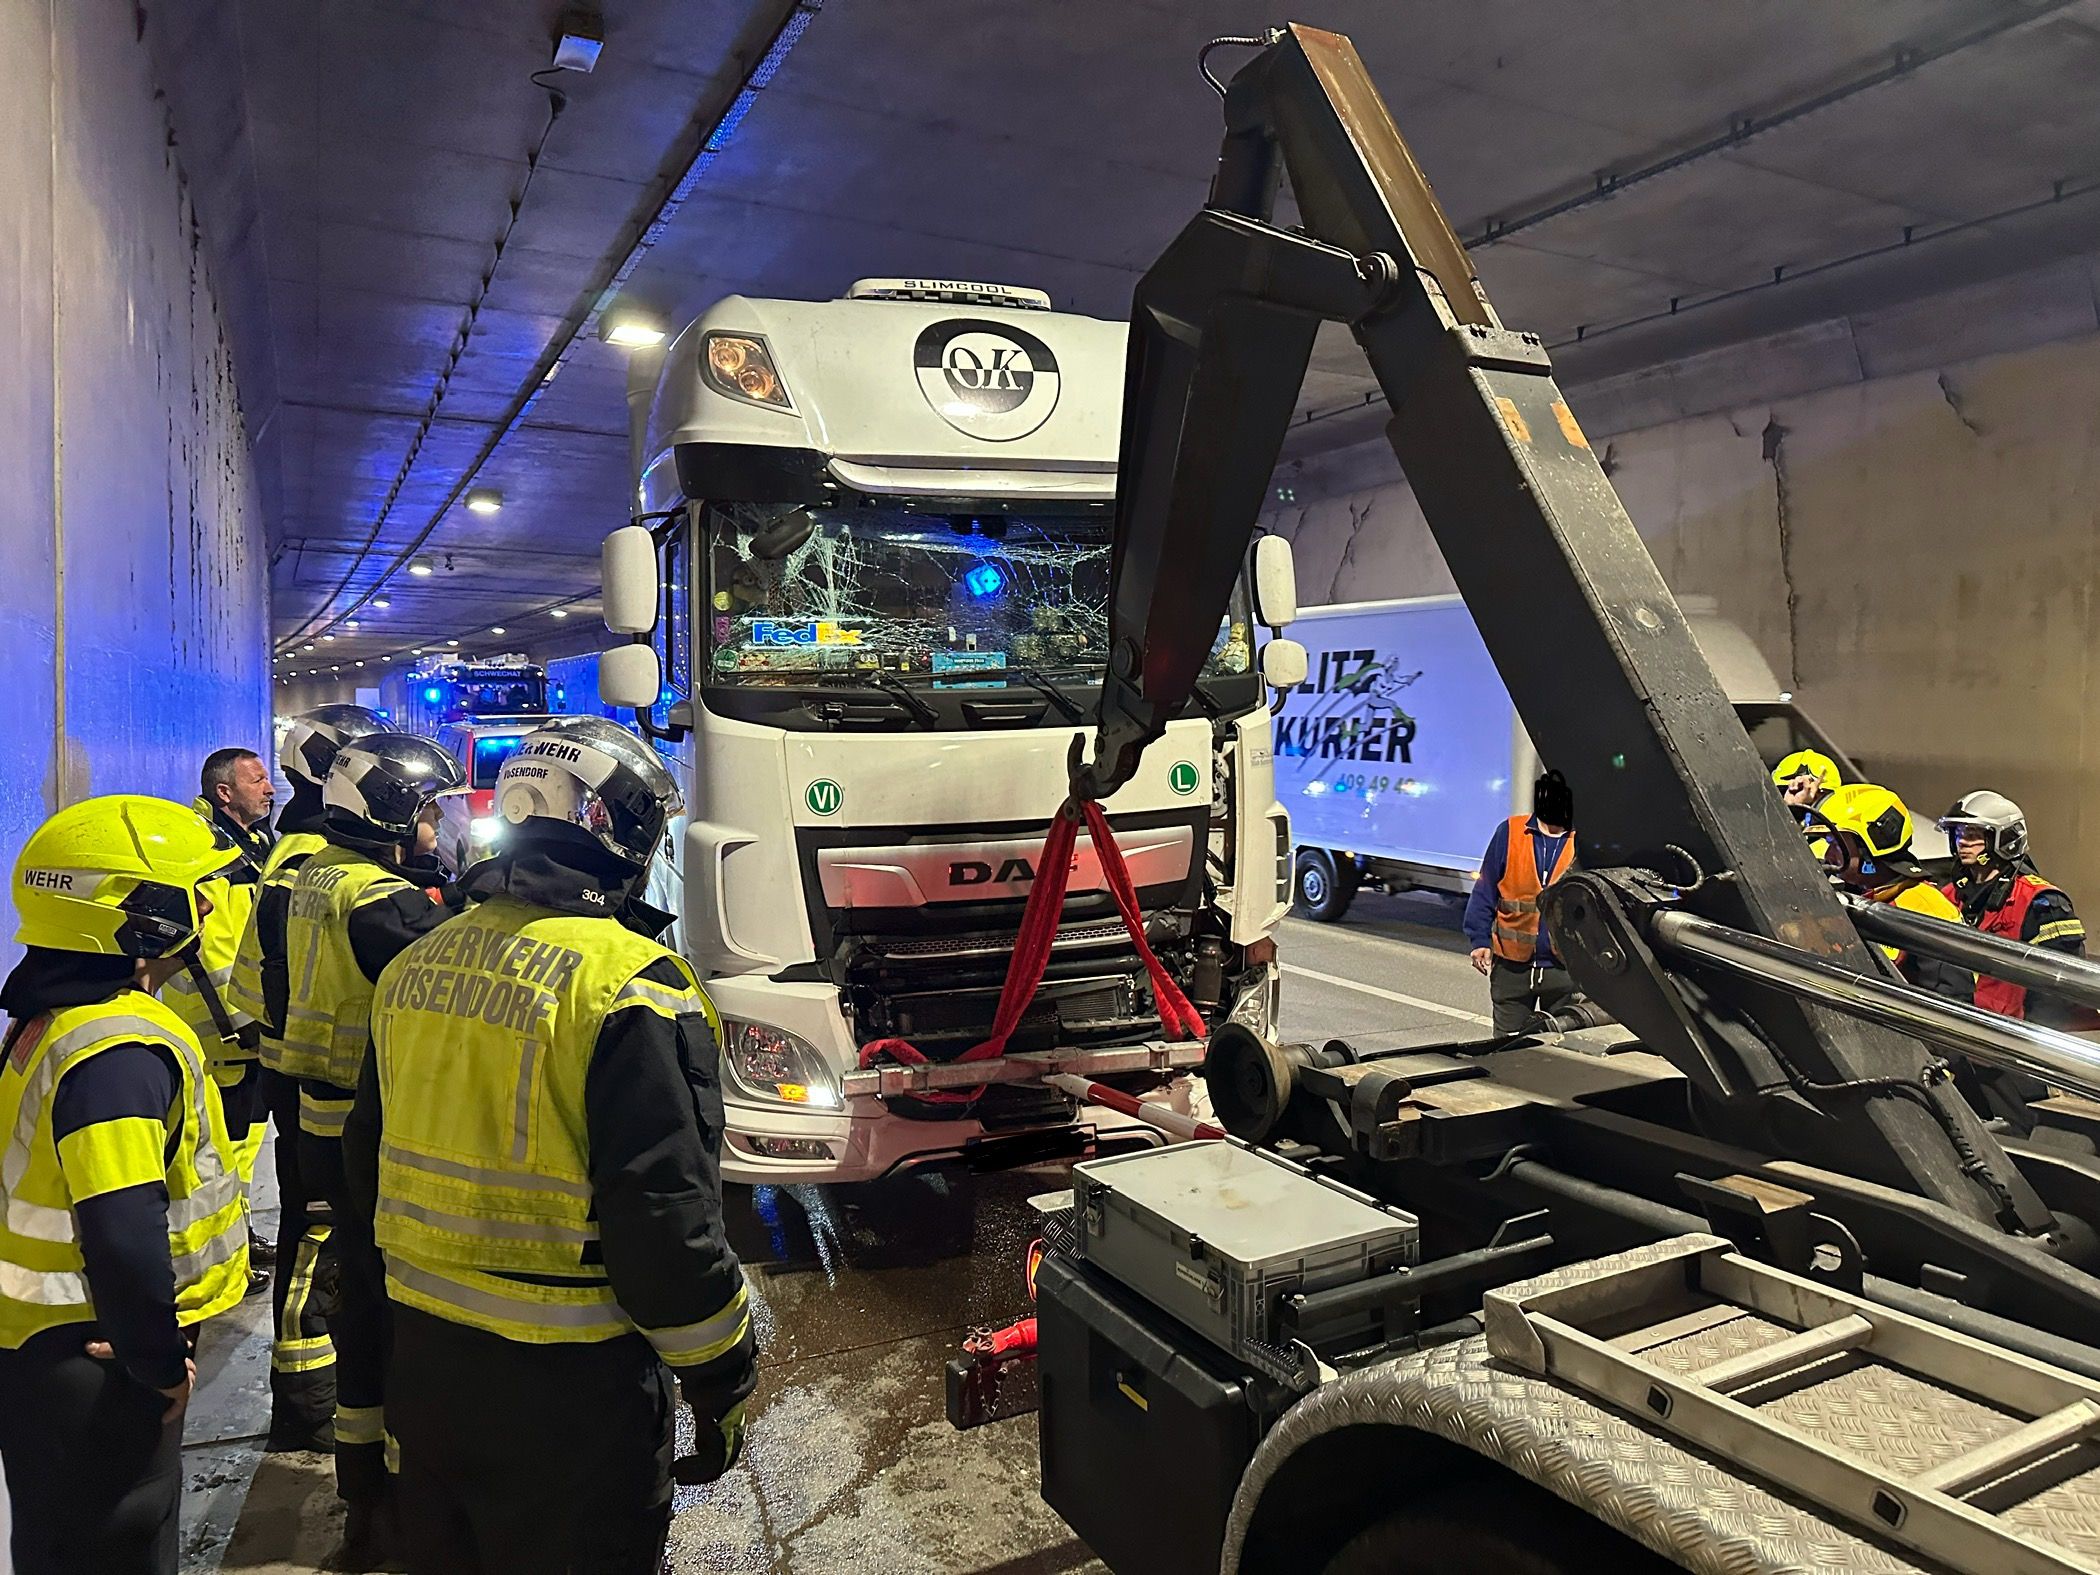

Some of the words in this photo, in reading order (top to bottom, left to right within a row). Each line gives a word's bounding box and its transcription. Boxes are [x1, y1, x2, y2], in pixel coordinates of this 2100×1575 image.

[904, 280, 1012, 295] SLIMCOOL
[752, 621, 863, 645] FedEx
[474, 670, 521, 678] SCHWECHAT
[1275, 649, 1382, 695] LITZ
[1274, 716, 1416, 763] KURIER
[1174, 767, 1191, 790] L
[1369, 775, 1390, 793] 49
[813, 785, 836, 810] VI
[25, 869, 73, 891] WEHR
[948, 854, 1078, 887] DA
[582, 888, 605, 907] 304
